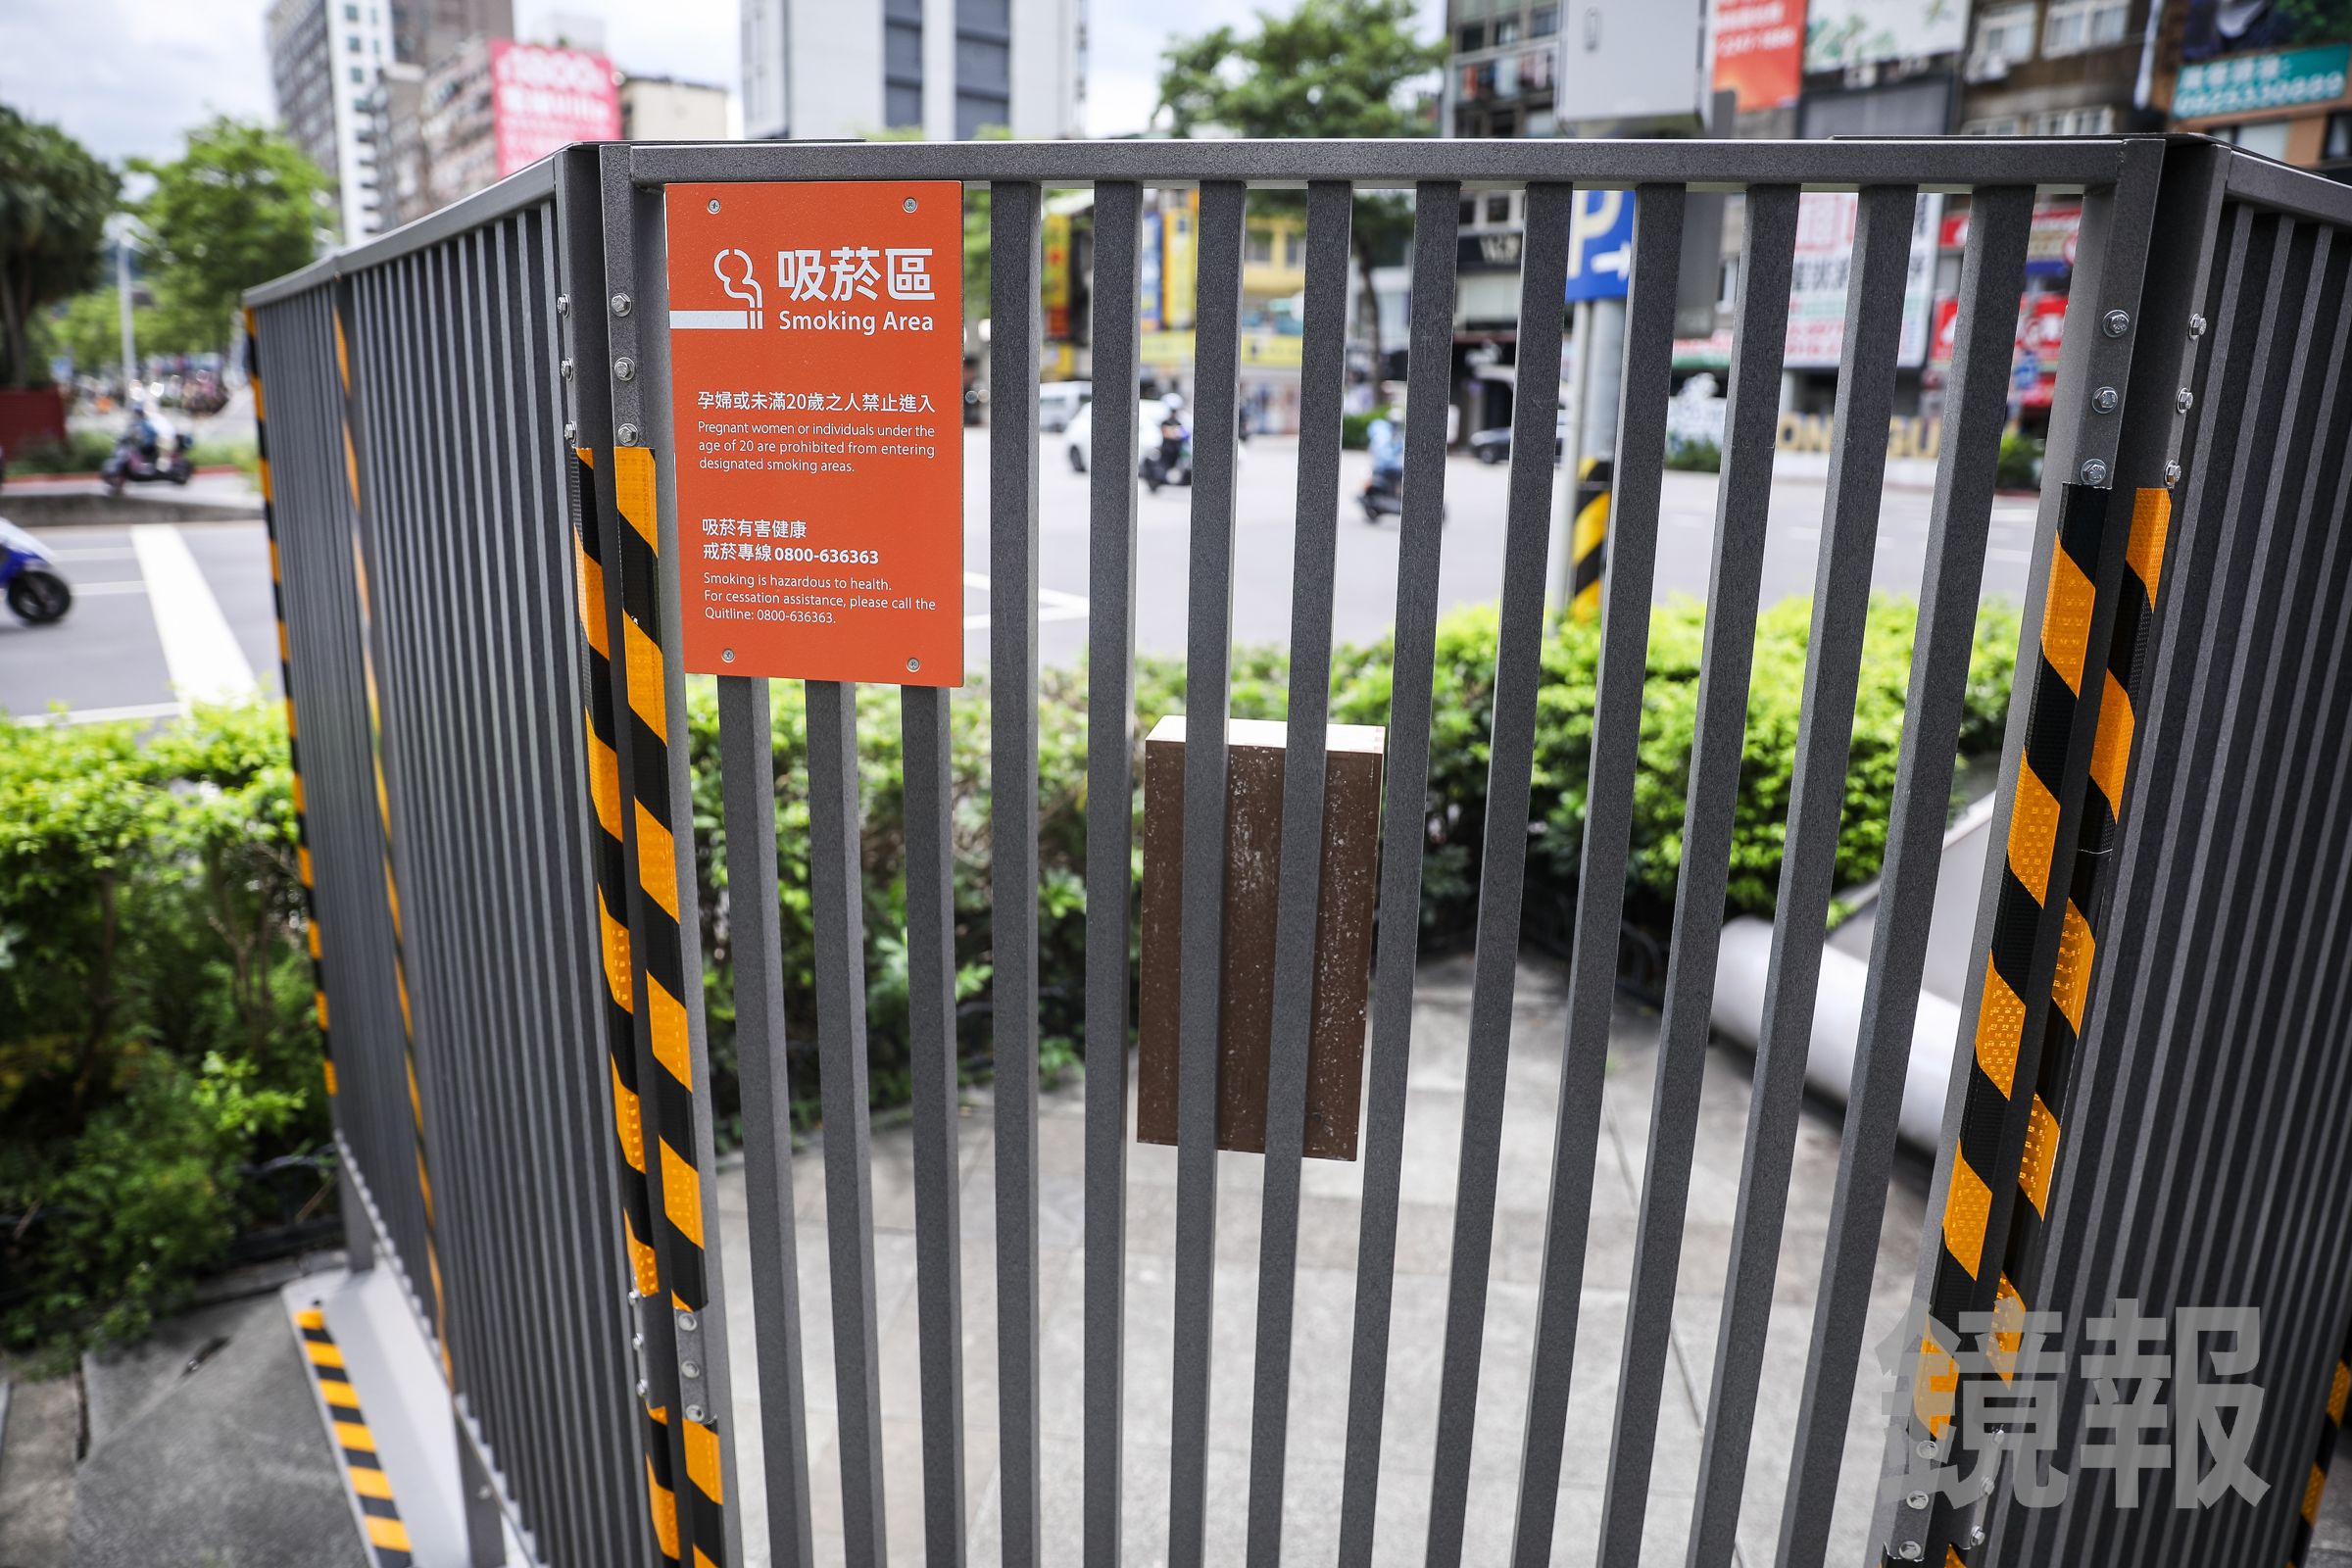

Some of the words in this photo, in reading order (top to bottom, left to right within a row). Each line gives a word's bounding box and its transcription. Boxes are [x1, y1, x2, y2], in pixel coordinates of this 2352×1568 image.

[1568, 191, 1623, 279] P
[777, 245, 936, 302] 吸菸區
[779, 309, 876, 336] Smoking
[882, 310, 934, 331] Area
[697, 390, 936, 414] 孕婦或未滿20歲之人禁止進入
[698, 420, 750, 436] Pregnant
[751, 424, 795, 436] women
[797, 424, 810, 436] or
[812, 422, 875, 437] individuals
[877, 424, 913, 438] under
[914, 425, 936, 438] the
[698, 441, 721, 455] age
[723, 438, 737, 452] of
[739, 439, 755, 453] 20
[757, 442, 776, 453] are
[779, 440, 845, 456] prohibited
[847, 441, 877, 455] from
[880, 444, 935, 460] entering
[699, 456, 764, 472] designated
[766, 458, 818, 474] smoking
[820, 462, 856, 472] areas.
[702, 517, 808, 539] 吸菸有害健康
[703, 541, 772, 563] 戒菸專線
[773, 546, 879, 565] 0800-636363
[704, 571, 755, 589] Smoking
[758, 573, 767, 586] is
[769, 573, 831, 589] hazardous
[834, 575, 848, 590] to
[850, 576, 893, 592] health.
[704, 589, 723, 602] For
[725, 591, 780, 605] cessation
[783, 594, 847, 609] assistance,
[850, 596, 889, 611] please
[891, 597, 912, 610] call
[914, 597, 936, 611] the
[705, 606, 755, 620] Quitline:
[757, 609, 837, 624] 0800-636363.
